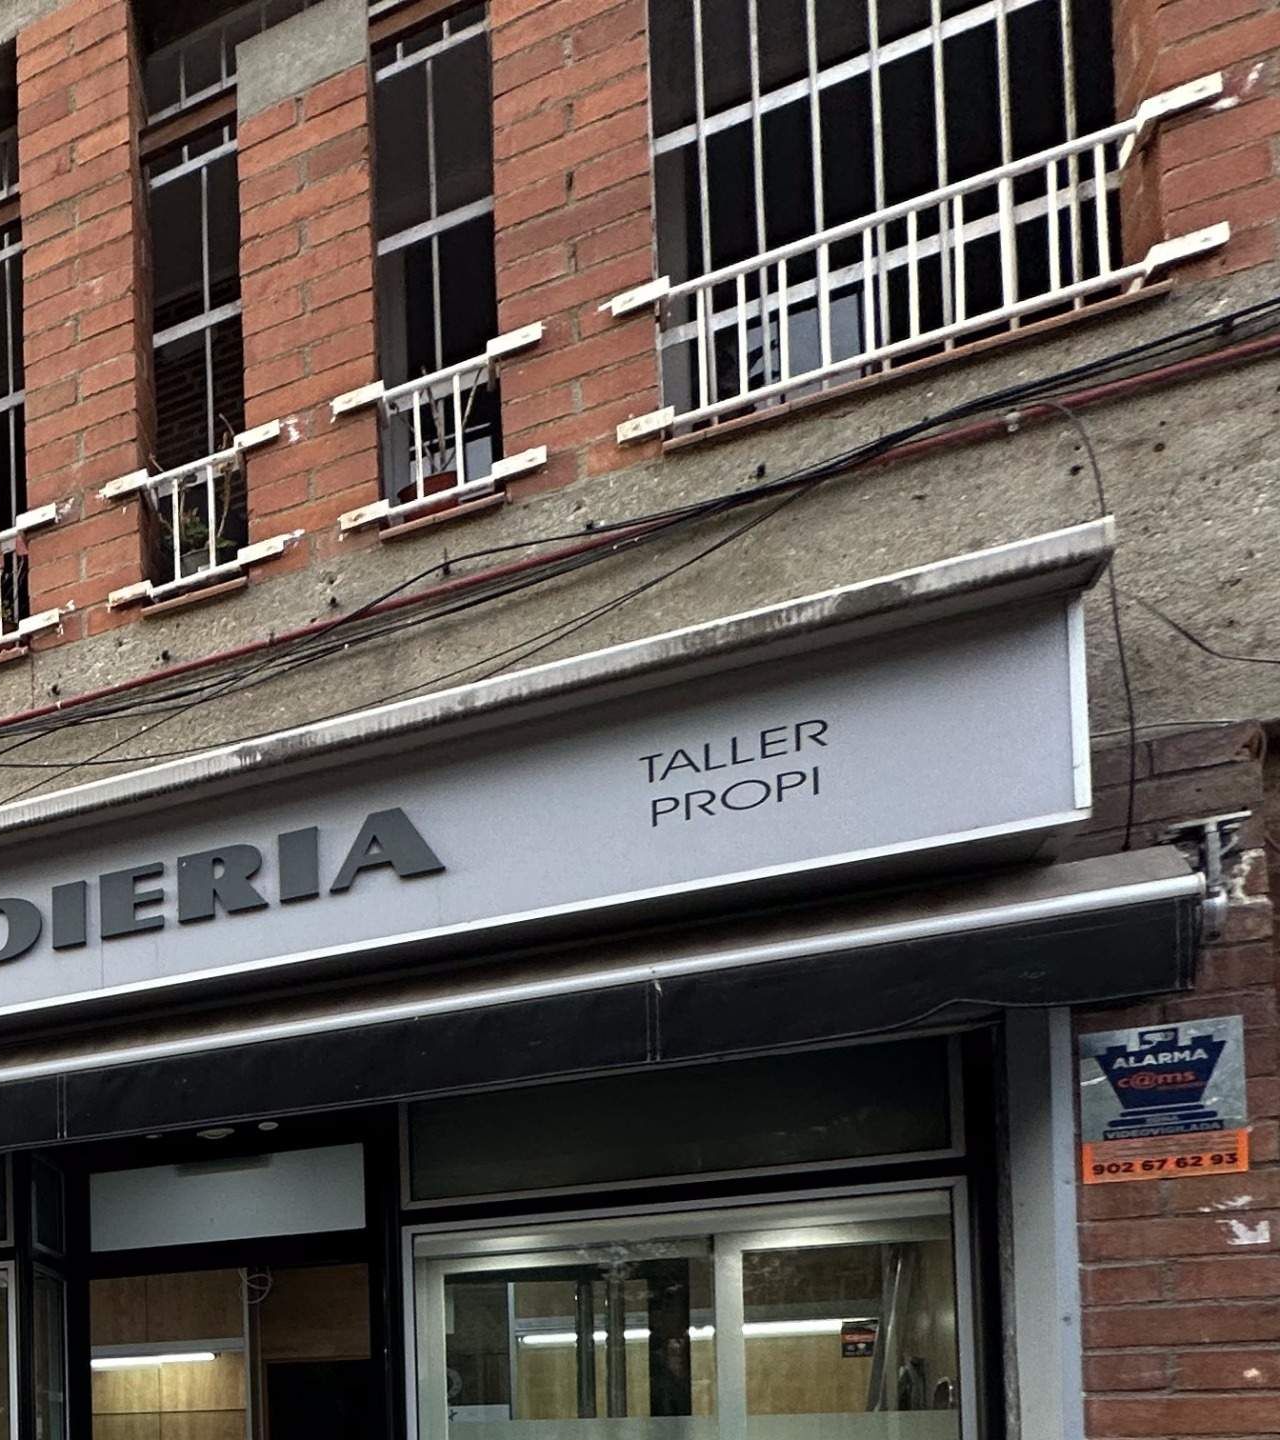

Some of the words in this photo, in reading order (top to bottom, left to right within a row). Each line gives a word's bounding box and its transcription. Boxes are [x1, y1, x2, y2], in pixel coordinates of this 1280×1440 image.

[638, 717, 831, 785] TALLER
[650, 765, 823, 829] PROPI
[1112, 1048, 1209, 1070] ALARMA
[1092, 1161, 1134, 1176] 902
[1141, 1159, 1168, 1172] 67
[1175, 1156, 1203, 1169] 62
[1210, 1152, 1238, 1165] 93
